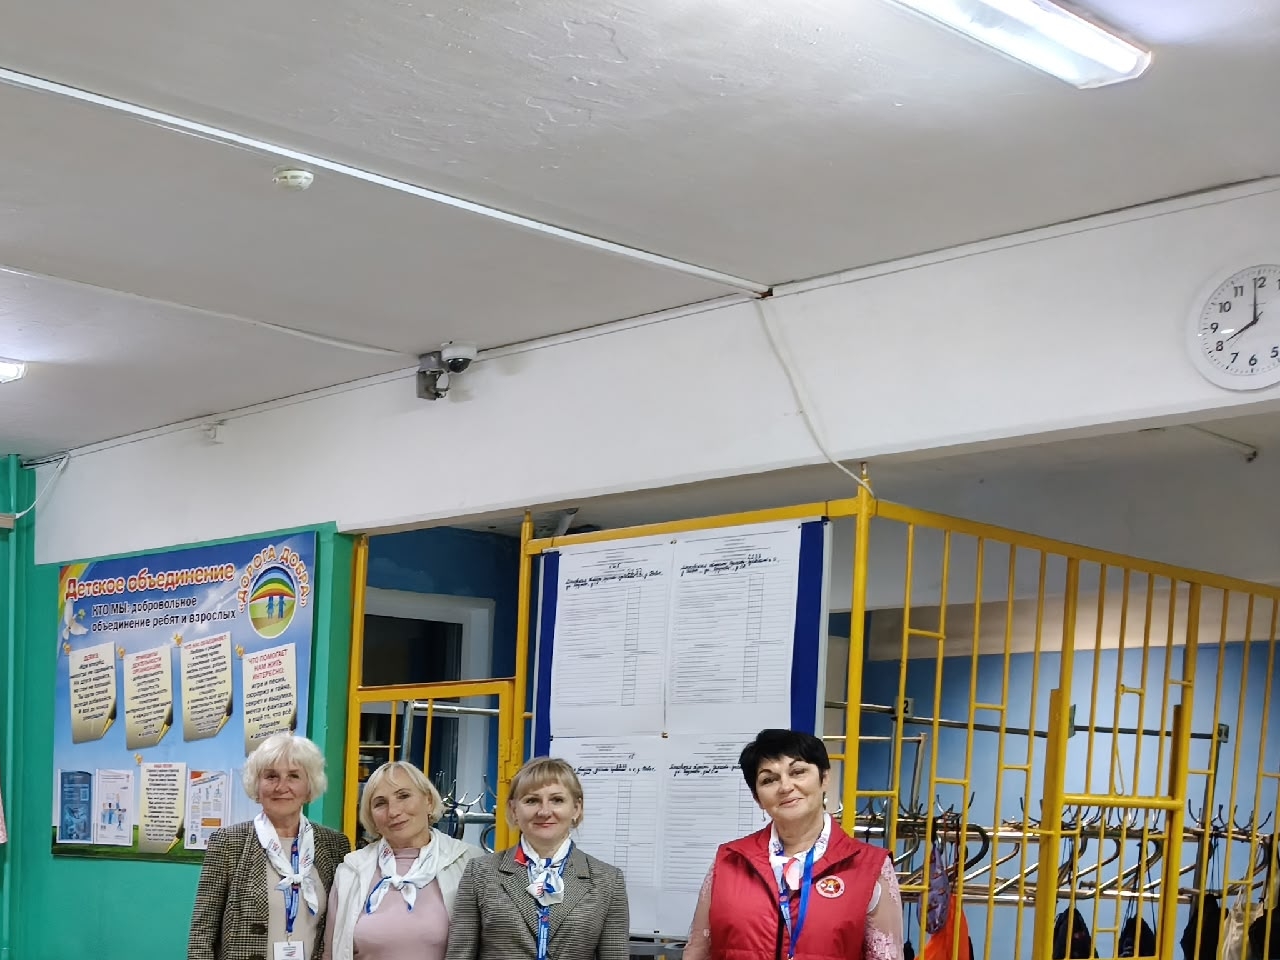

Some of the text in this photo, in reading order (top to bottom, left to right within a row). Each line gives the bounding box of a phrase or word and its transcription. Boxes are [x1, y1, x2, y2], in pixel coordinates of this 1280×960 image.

[1234, 286, 1244, 297] 11
[1219, 301, 1231, 313] 10
[1210, 323, 1218, 333] 9
[1216, 341, 1224, 351] 8
[1231, 352, 1239, 363] 7
[1271, 347, 1279, 358] 5
[1249, 354, 1257, 366] 6
[65, 563, 235, 601] Детское объединение
[92, 597, 197, 617] КТО МЫ: добровольное
[92, 618, 151, 632] объединение
[153, 614, 180, 628] ребят
[189, 609, 236, 624] взрослых
